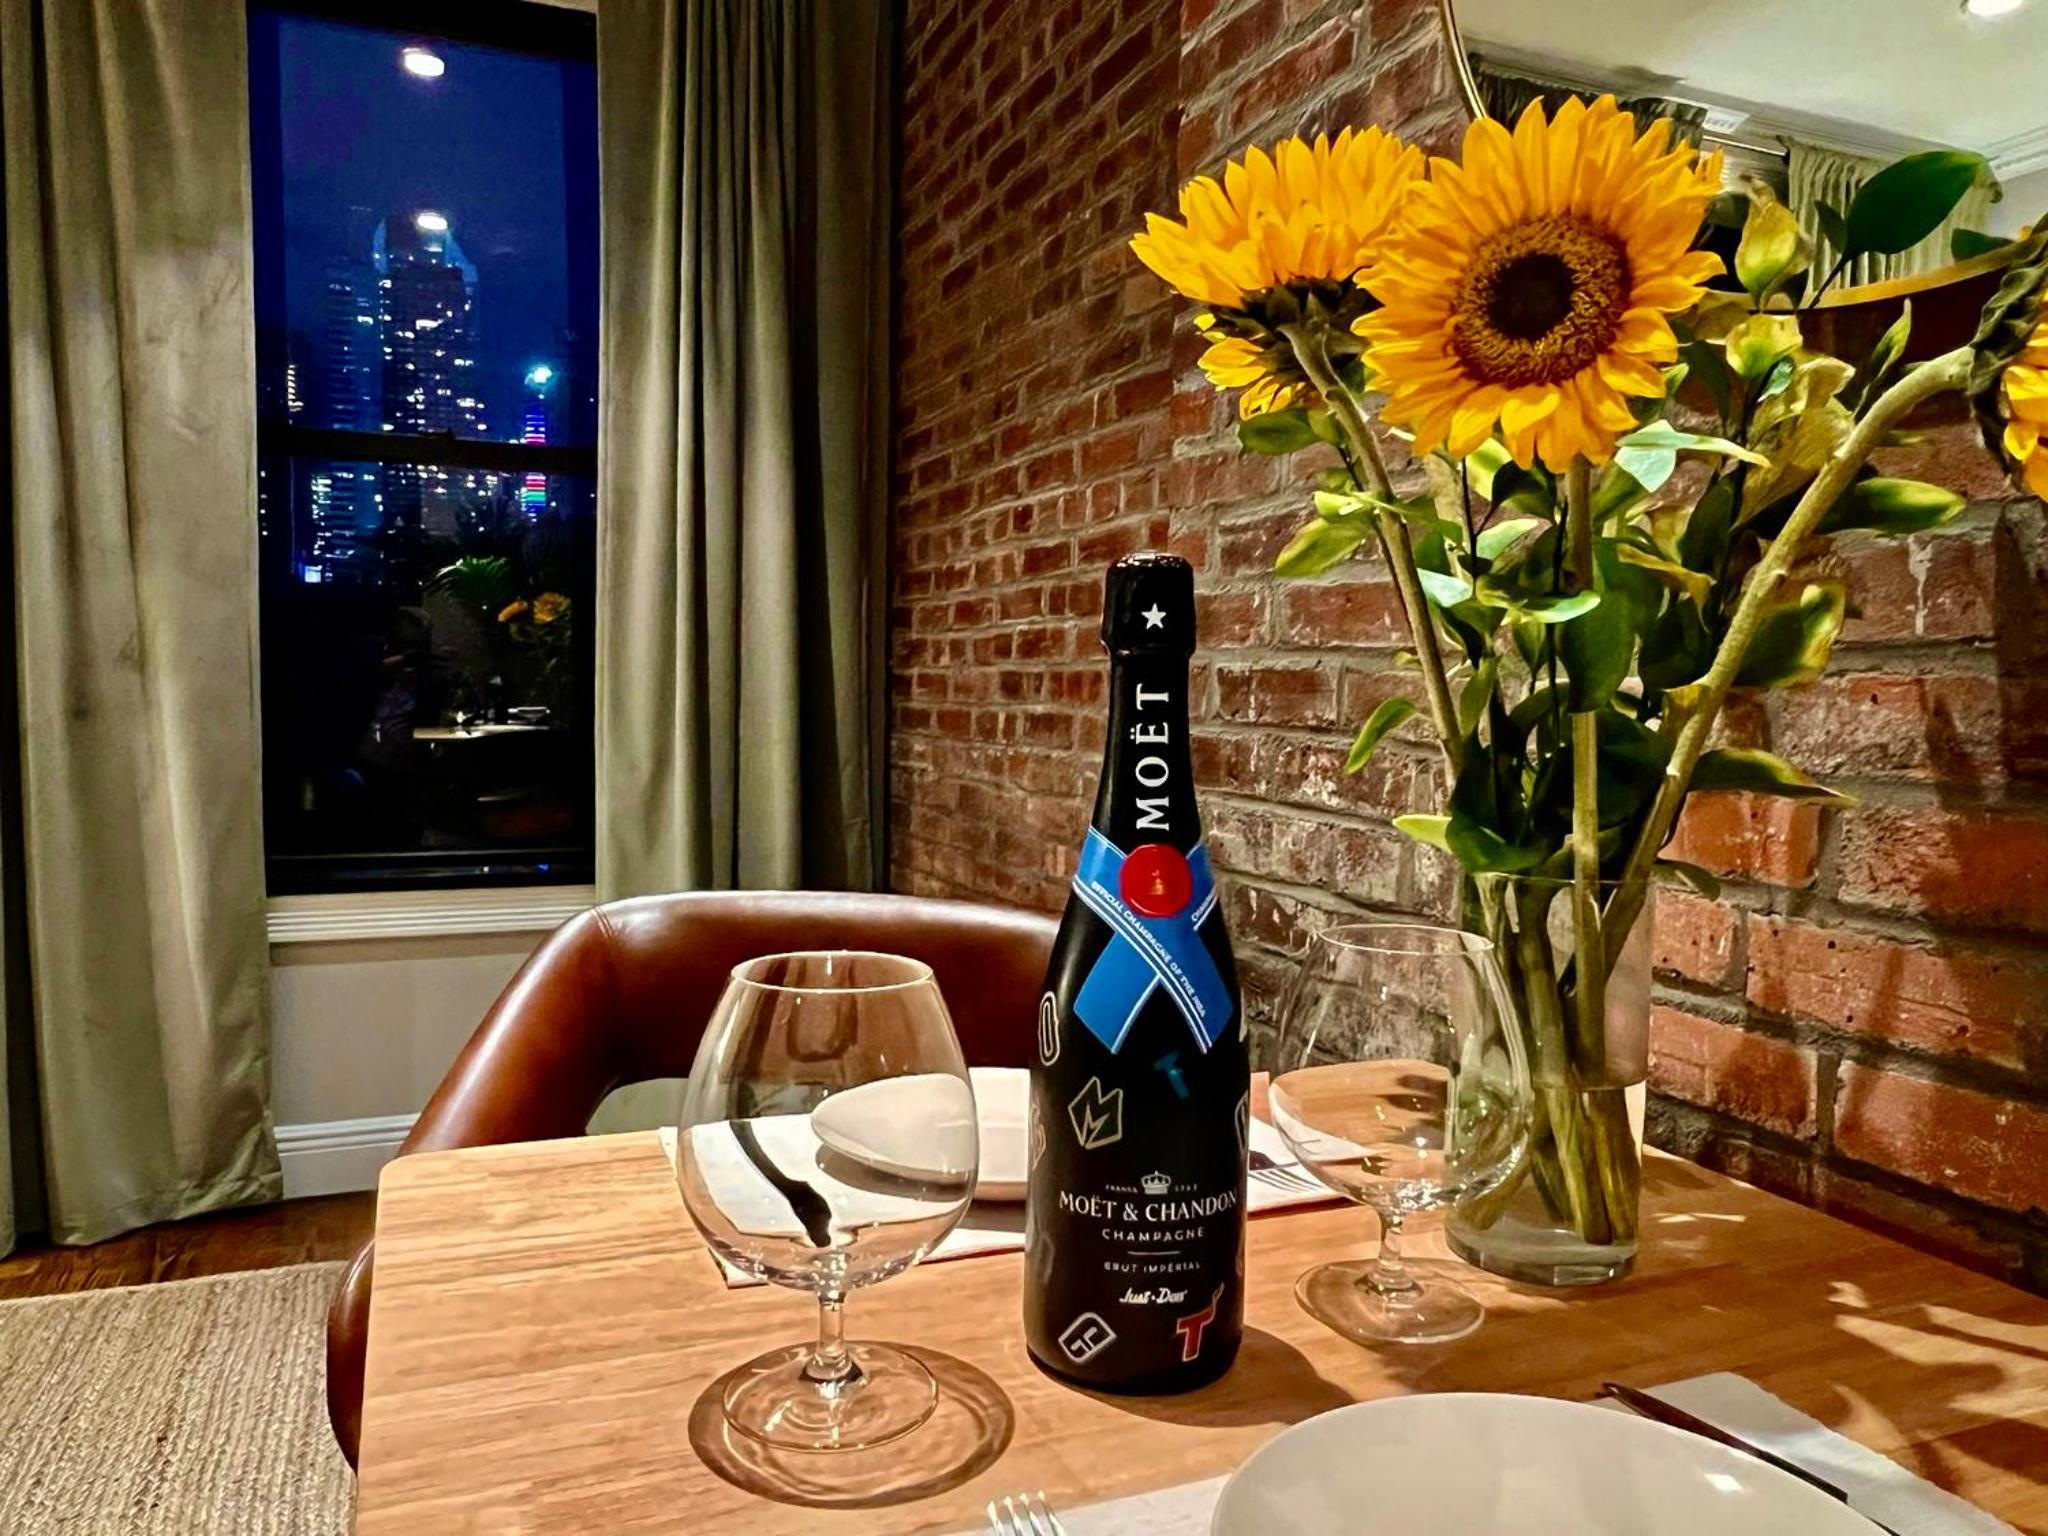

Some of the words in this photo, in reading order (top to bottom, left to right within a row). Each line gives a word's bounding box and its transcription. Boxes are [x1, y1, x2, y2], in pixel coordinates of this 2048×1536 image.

[1130, 683, 1170, 831] MOËT
[1123, 908, 1172, 964] CHAMPAGNE
[1170, 961, 1183, 977] OF
[1180, 975, 1199, 1003] THE
[1058, 1190, 1118, 1219] MOËT
[1122, 1202, 1139, 1221] &
[1144, 1187, 1238, 1222] CHANDON
[1101, 1226, 1206, 1242] CHAMPAGNE
[1104, 1261, 1137, 1273] BRUT
